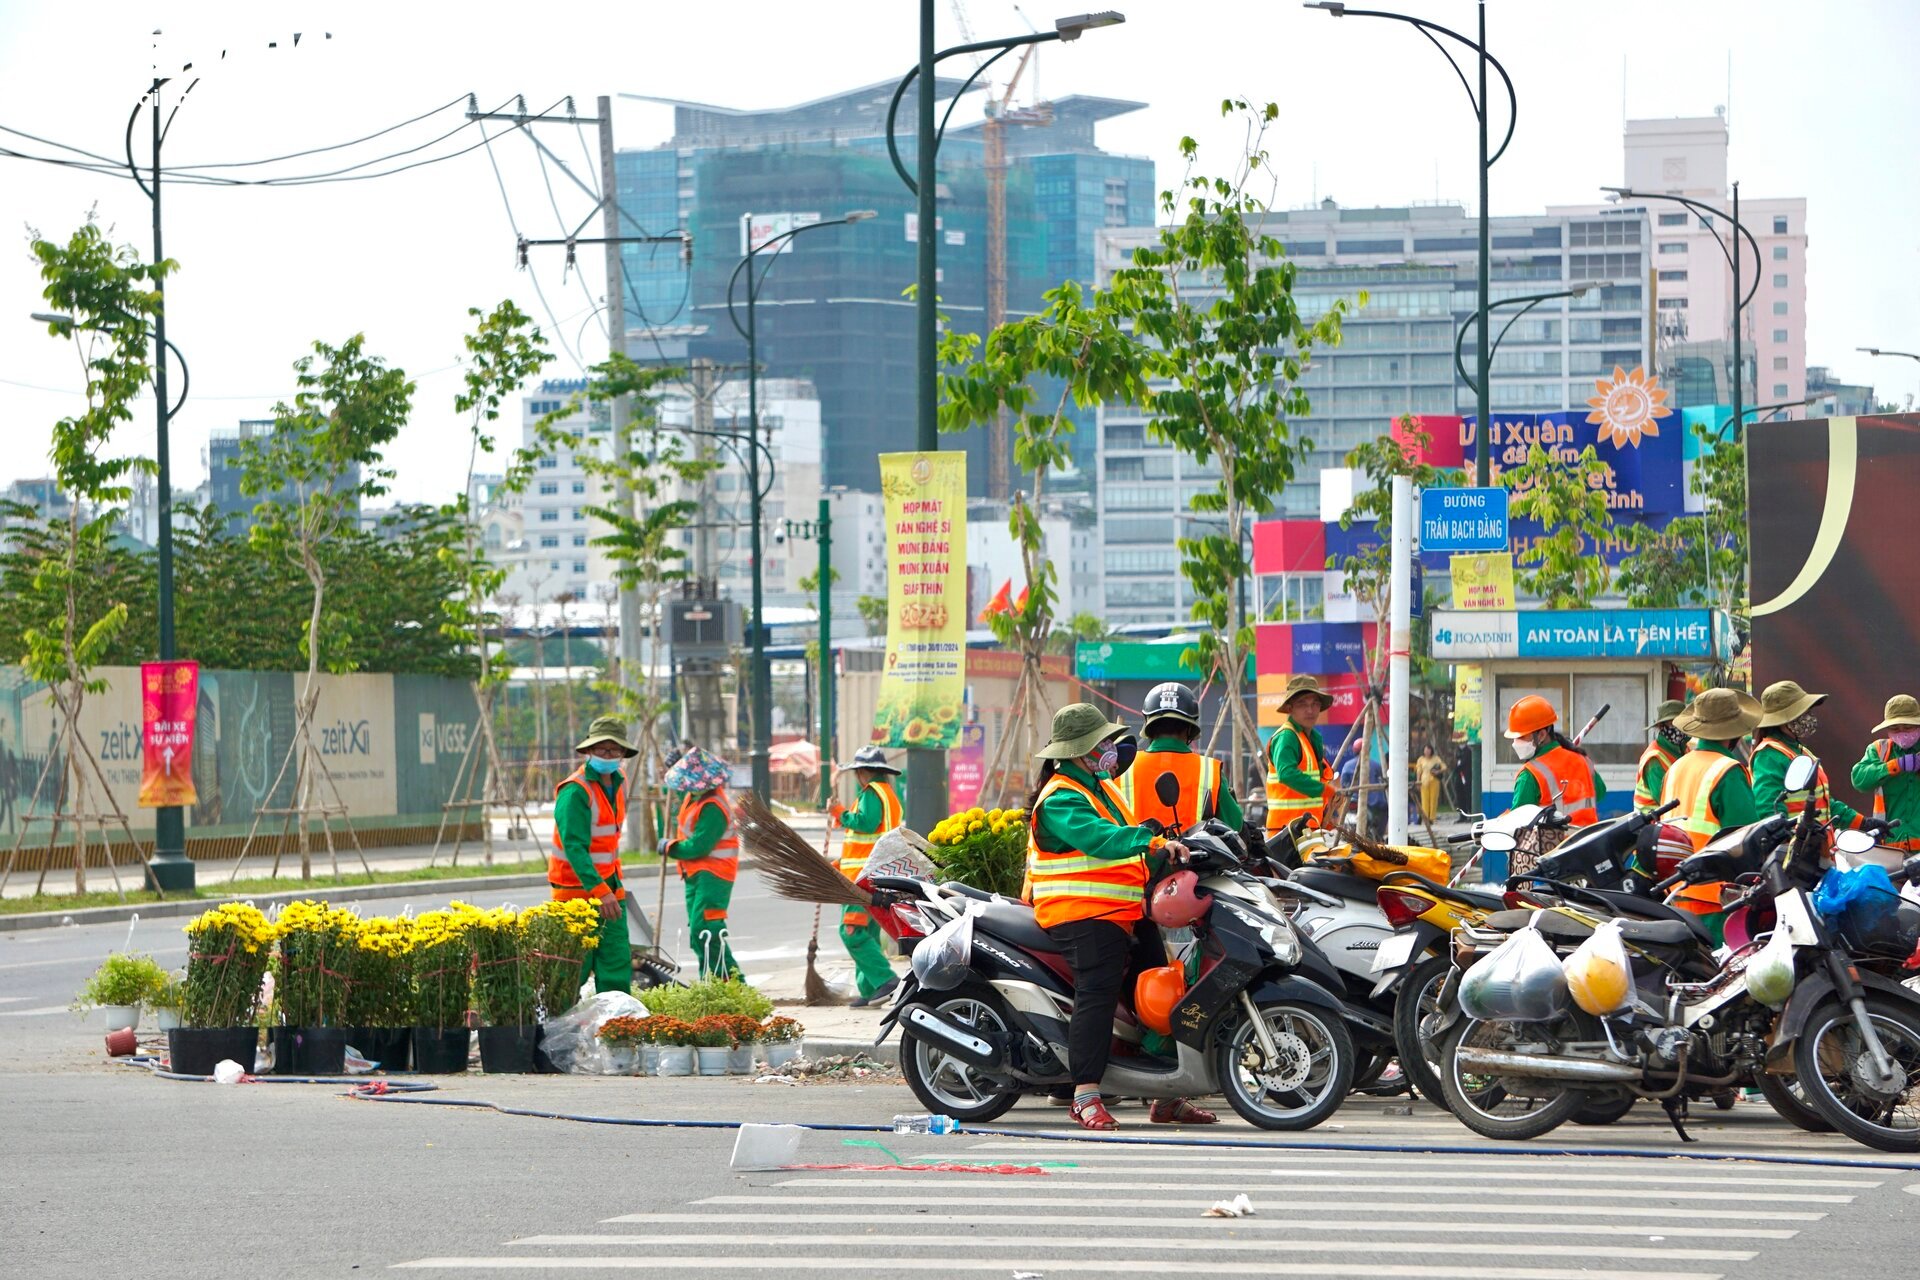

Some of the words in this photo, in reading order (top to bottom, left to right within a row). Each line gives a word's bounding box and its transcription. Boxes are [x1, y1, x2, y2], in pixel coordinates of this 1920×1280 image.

[1505, 420, 1574, 444] Xuân
[1443, 493, 1486, 508] ĐƯỜNG
[1425, 513, 1449, 539] TRẦN
[1451, 519, 1475, 542] BẠCH
[1477, 512, 1503, 539] ĐẰNG
[1526, 629, 1550, 643] AN
[1553, 625, 1599, 643] TOÀN
[1603, 625, 1625, 643] LÀ
[1675, 620, 1707, 641] HẾT
[173, 721, 187, 732] XE
